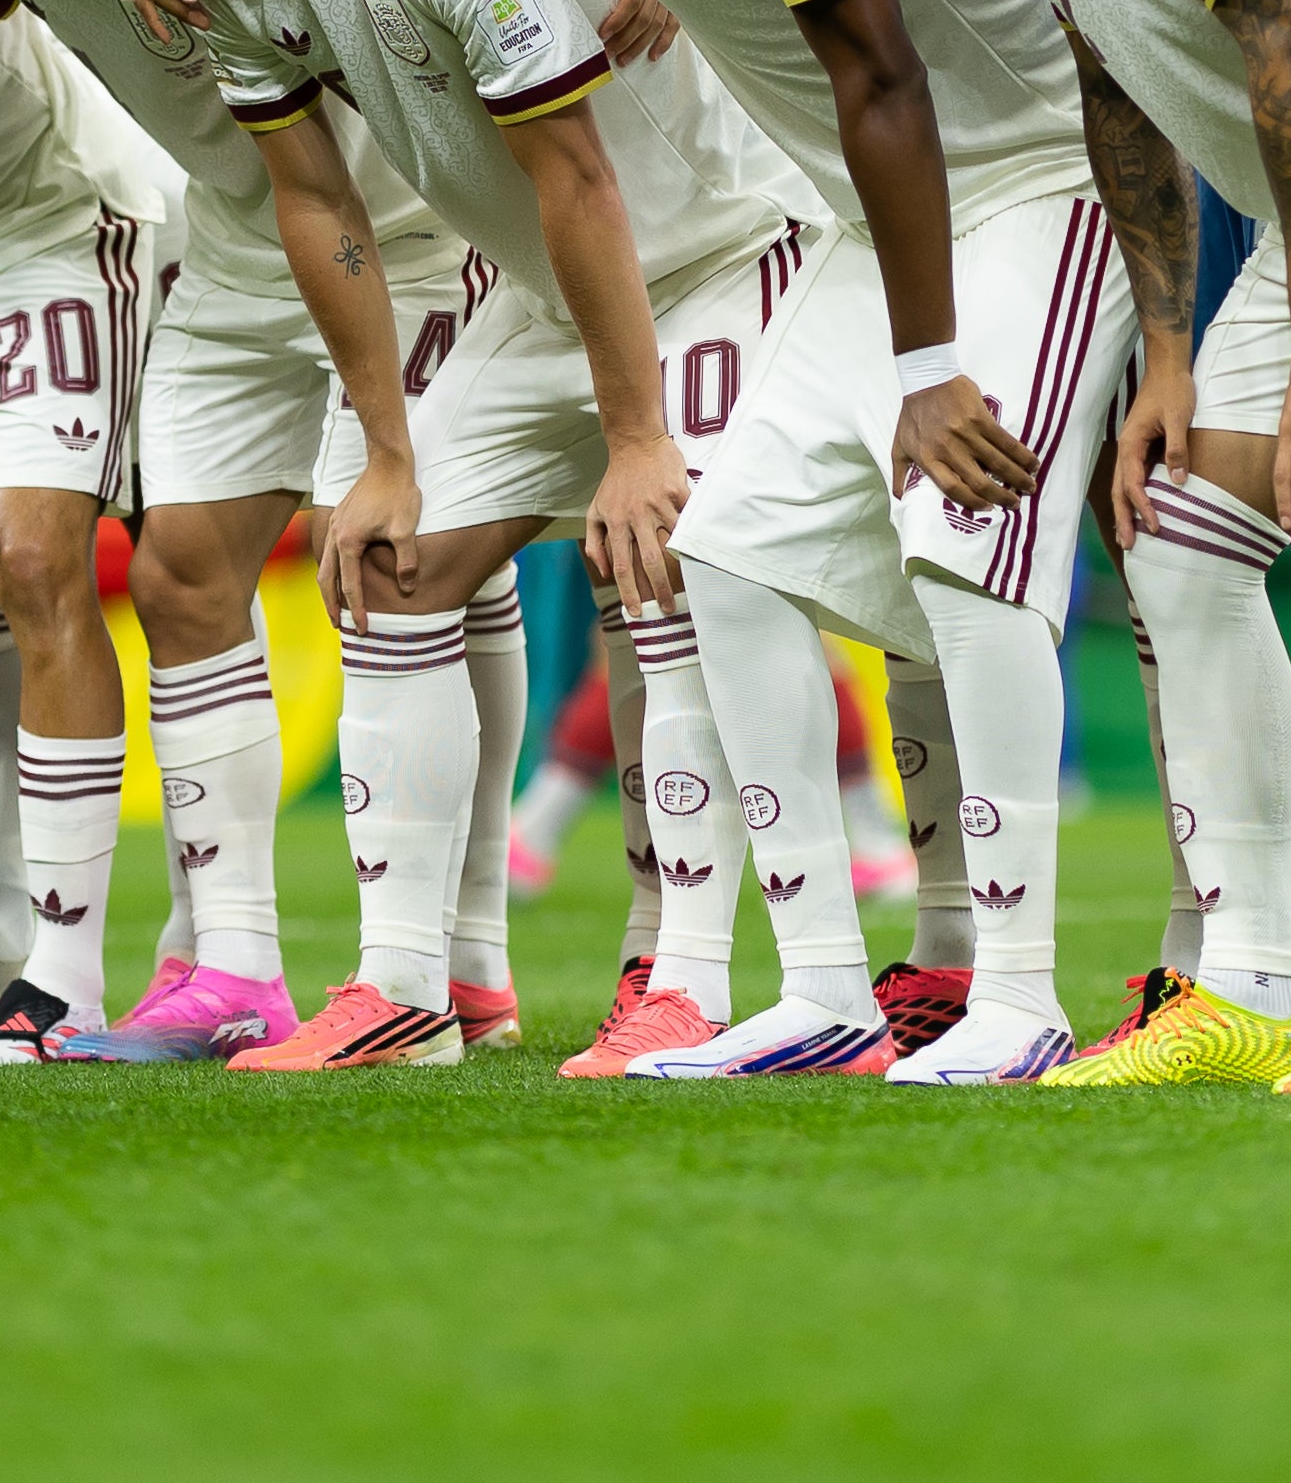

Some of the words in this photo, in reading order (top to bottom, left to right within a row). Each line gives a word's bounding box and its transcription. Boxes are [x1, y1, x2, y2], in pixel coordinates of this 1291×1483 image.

[498, 19, 521, 39] Unite
[516, 12, 530, 28] For
[498, 22, 543, 53] EDUCATION
[517, 42, 534, 55] FIFA
[660, 337, 741, 440] 0
[664, 780, 695, 793] RF
[664, 794, 694, 807] EF
[743, 792, 765, 808] RF
[747, 805, 769, 821] EF
[962, 804, 986, 816] RF
[964, 817, 988, 829] EF
